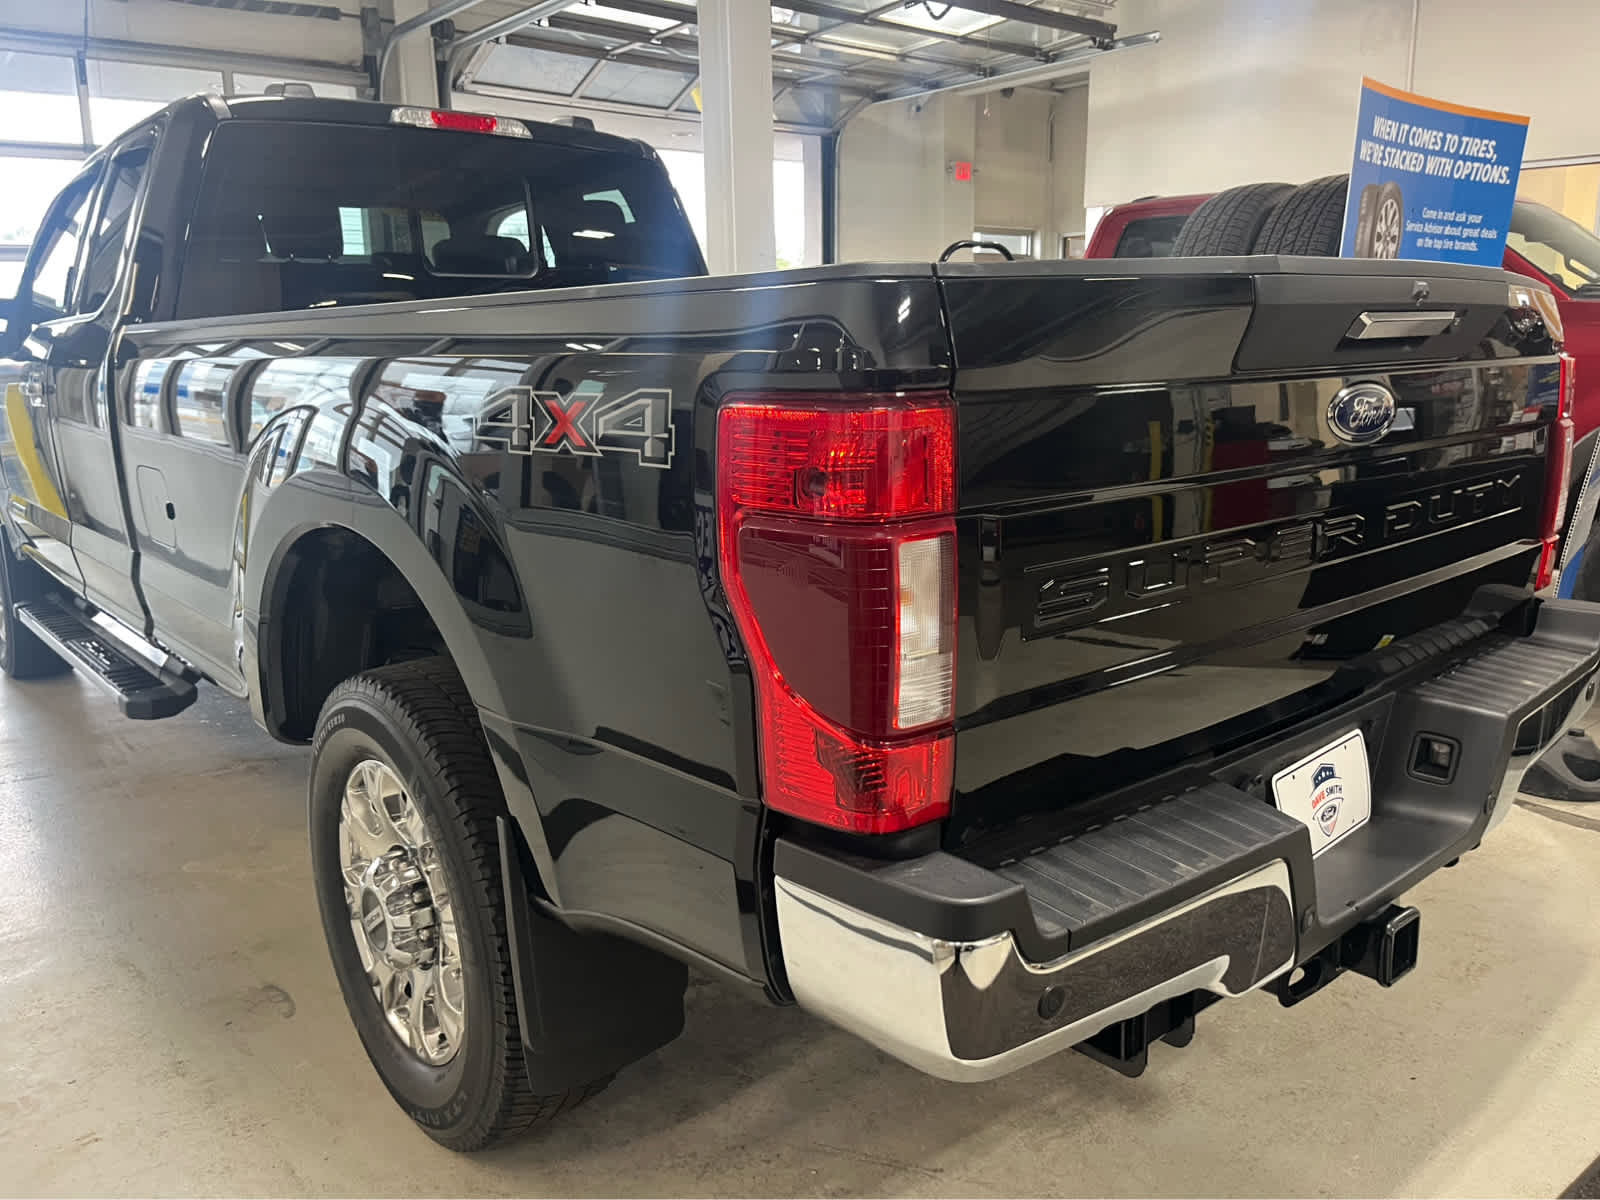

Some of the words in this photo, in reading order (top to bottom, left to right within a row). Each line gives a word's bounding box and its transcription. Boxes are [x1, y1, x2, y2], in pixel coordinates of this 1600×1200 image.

[1373, 116, 1398, 140] WHEN
[1397, 124, 1410, 144] IT
[1410, 126, 1443, 150] COMES
[1444, 133, 1459, 153] TO
[1460, 137, 1497, 162] TIRES,
[1360, 140, 1384, 165] WE'RE
[1383, 148, 1424, 172] STACKED
[1426, 155, 1453, 177] WITH
[1453, 160, 1511, 185] OPTIONS.
[1405, 220, 1424, 233] Service
[1444, 224, 1462, 236] about
[1480, 227, 1498, 239] deals
[1422, 207, 1437, 219] Come
[1466, 214, 1483, 225] your
[1034, 512, 1367, 629] SUPER
[1383, 472, 1523, 540] DUTY
[1312, 790, 1325, 809] DAVE
[1326, 784, 1342, 796] SMITH
